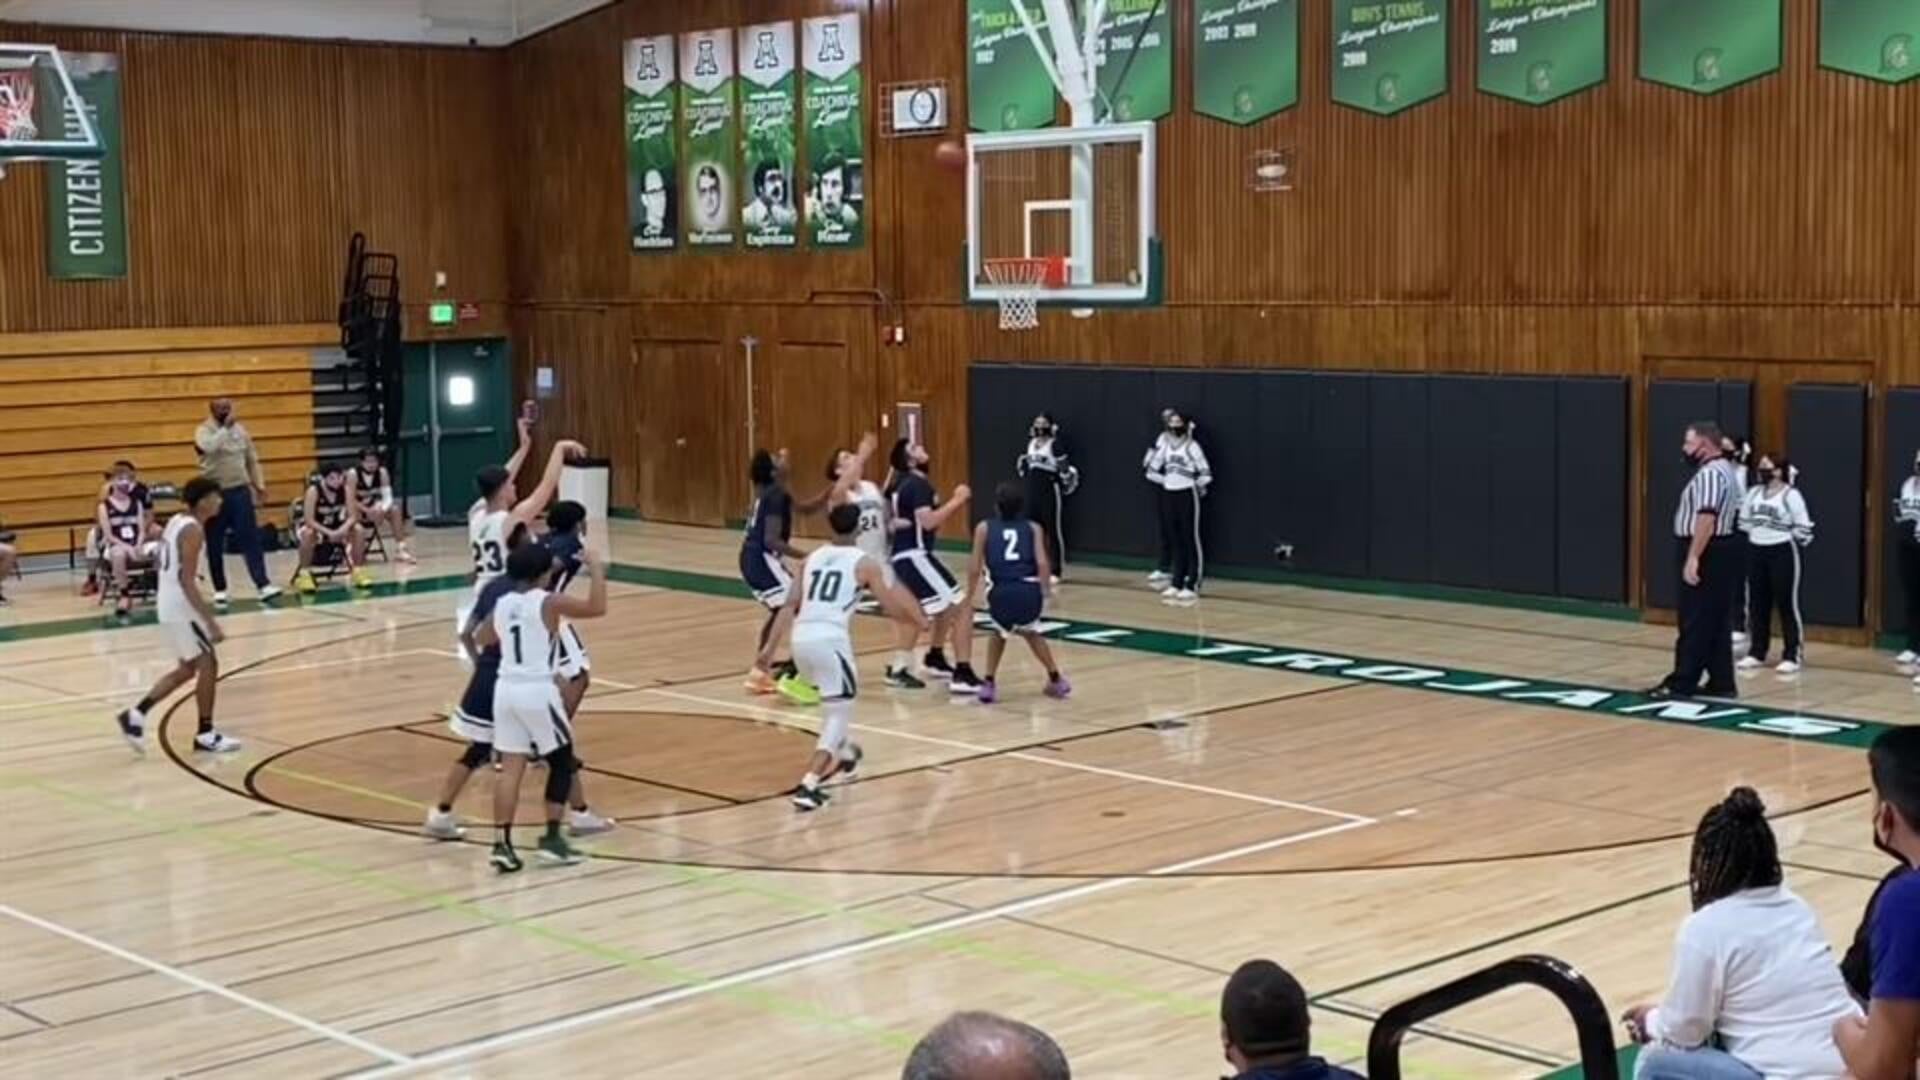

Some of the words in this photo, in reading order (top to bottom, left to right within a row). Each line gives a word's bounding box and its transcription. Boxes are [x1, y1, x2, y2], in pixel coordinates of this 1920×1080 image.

[1003, 528, 1020, 560] 2
[807, 569, 843, 603] 10
[509, 624, 523, 665] 1
[1184, 642, 1861, 737] TROJANS
